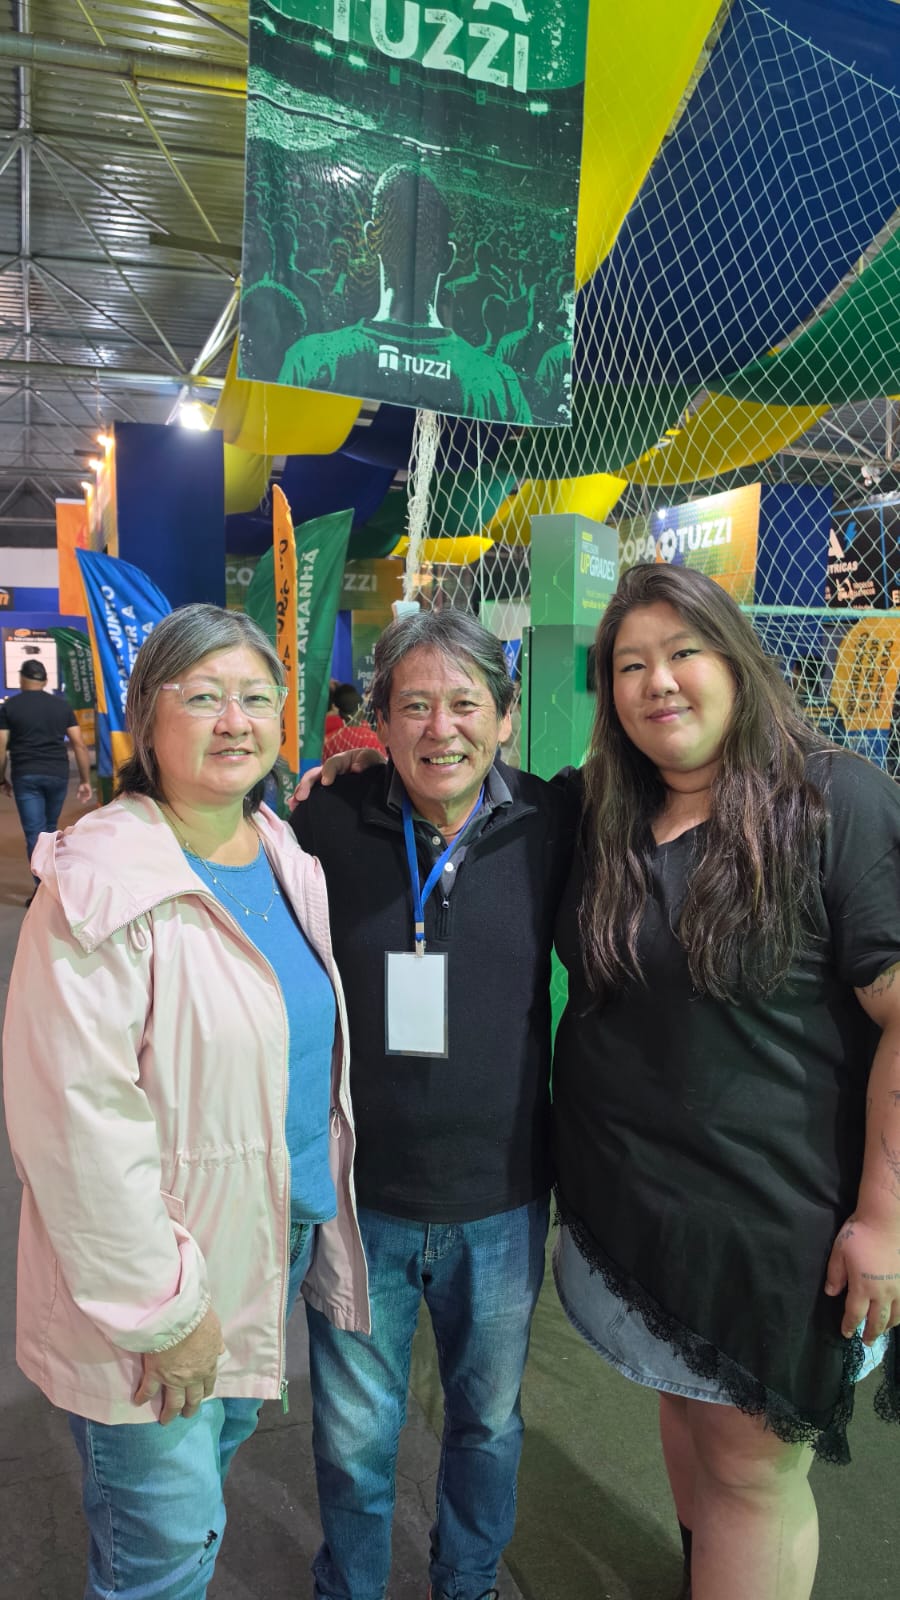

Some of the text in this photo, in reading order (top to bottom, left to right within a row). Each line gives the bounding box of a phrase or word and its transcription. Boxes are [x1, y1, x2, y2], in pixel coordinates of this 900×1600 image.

[676, 517, 732, 553] TUZZI
[580, 551, 616, 581] UPGRADES
[101, 585, 122, 649] JUNTO
[122, 605, 136, 619] A
[297, 547, 320, 655] AMANHÃ
